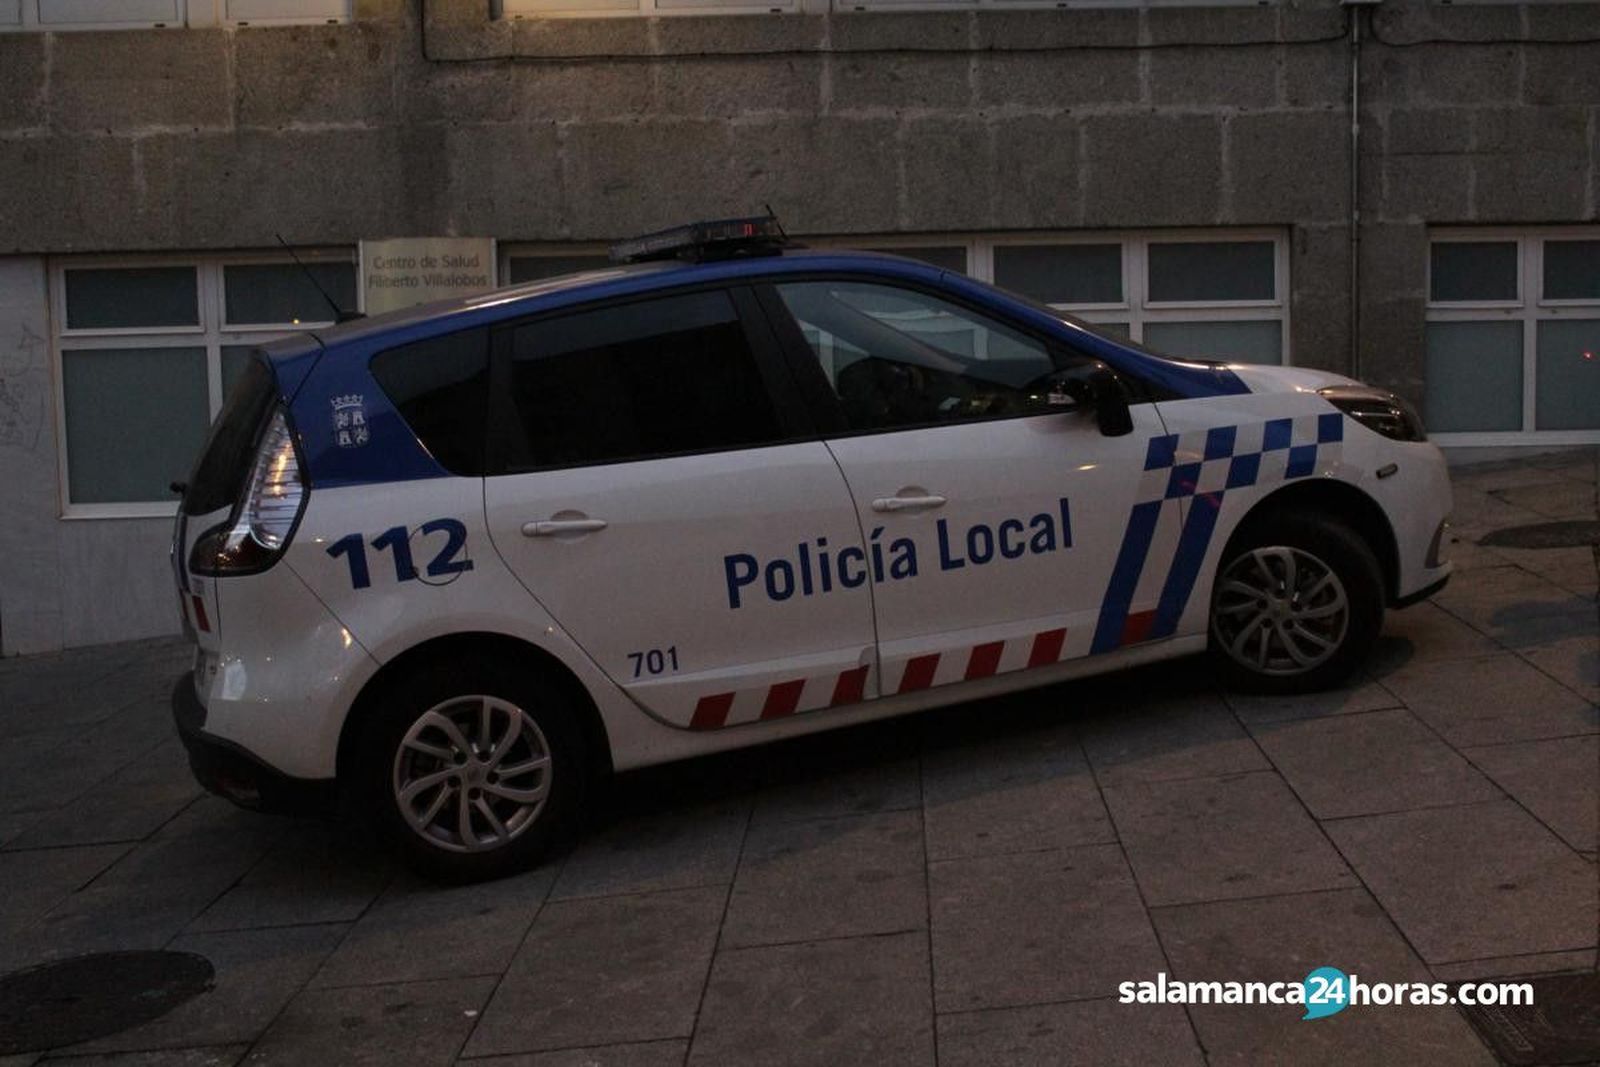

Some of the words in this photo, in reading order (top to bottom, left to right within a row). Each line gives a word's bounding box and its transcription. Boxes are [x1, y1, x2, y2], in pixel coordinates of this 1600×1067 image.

[373, 255, 416, 269] Centro
[420, 254, 438, 268] de
[443, 253, 480, 268] Salud
[422, 273, 487, 287] Villalobos
[326, 518, 474, 589] 112
[724, 526, 918, 609] Policía
[937, 498, 1072, 571] Local
[627, 646, 678, 678] 701
